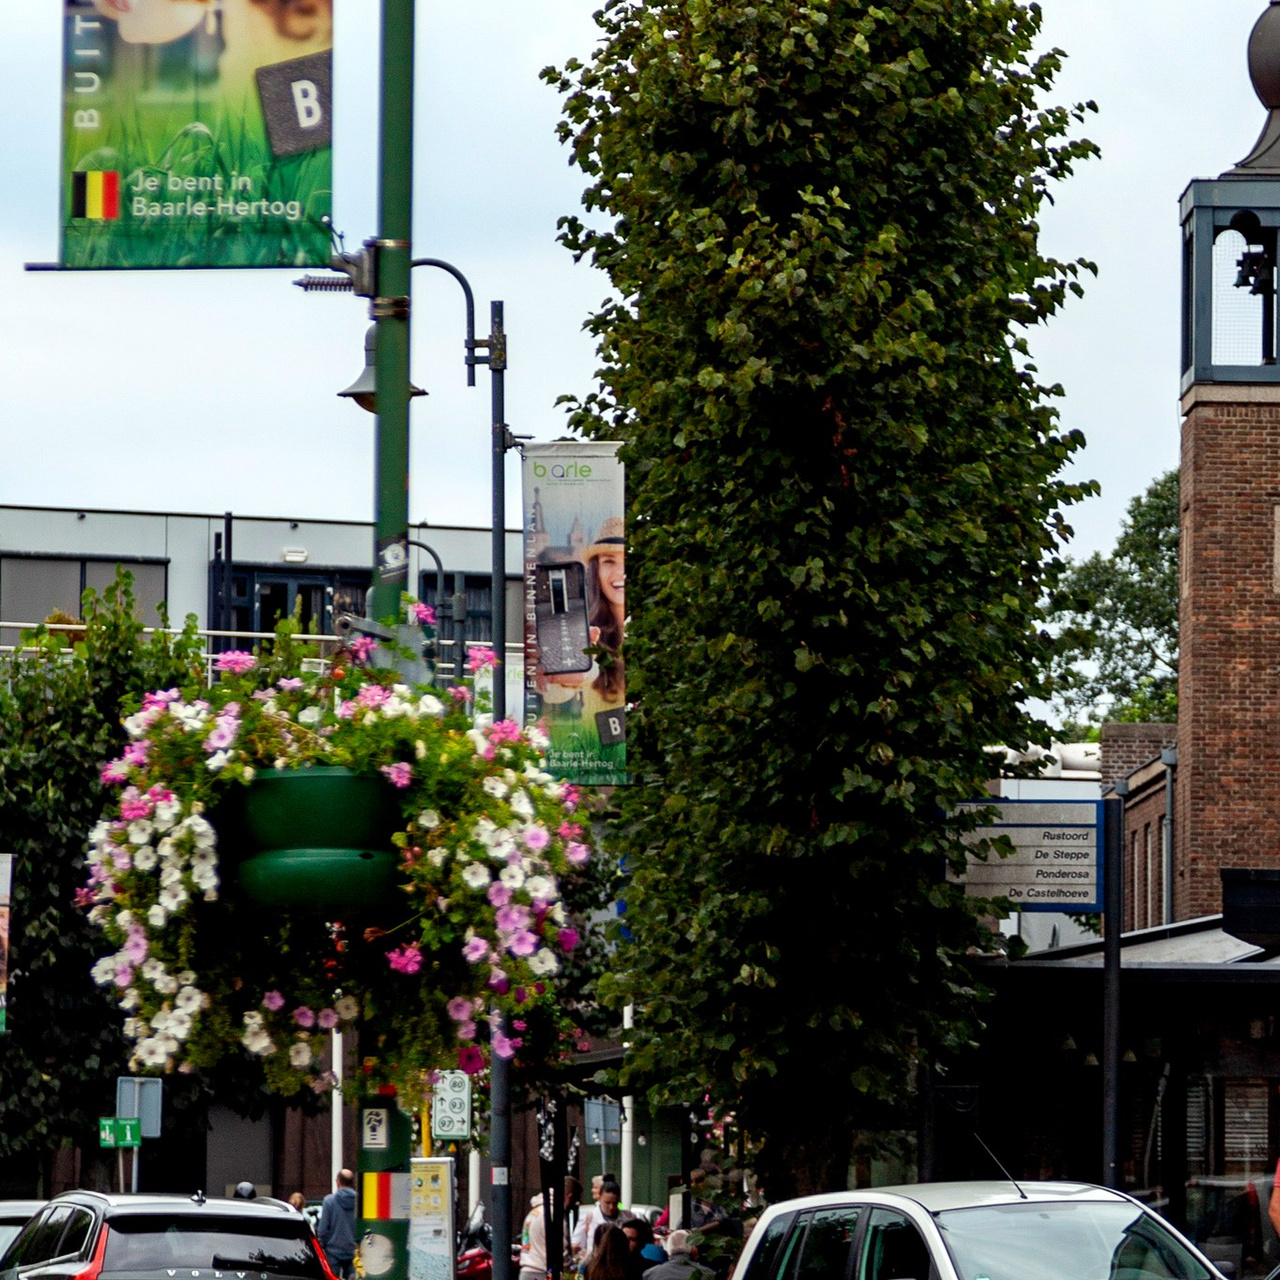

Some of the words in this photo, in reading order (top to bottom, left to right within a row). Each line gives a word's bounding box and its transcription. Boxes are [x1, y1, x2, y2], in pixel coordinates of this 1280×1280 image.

[291, 80, 321, 128] B
[132, 171, 159, 191] Je
[167, 171, 223, 191] bent
[230, 170, 252, 190] in
[132, 195, 301, 221] Baarle-Hertog
[527, 634, 538, 653] IN
[526, 665, 538, 730] UITEN
[608, 717, 621, 735] B
[562, 750, 584, 758] bent
[549, 759, 614, 769] Baarle-Hertog
[1042, 831, 1089, 840] Rustoord
[1035, 850, 1049, 859] De
[1053, 850, 1090, 860] Steppe
[1035, 869, 1090, 878] Ponderosa
[1009, 888, 1023, 897] De
[1027, 888, 1089, 898] Castelhoeve
[451, 1080, 463, 1088] 80
[451, 1102, 463, 1110] 93
[440, 1120, 453, 1128] 97
[166, 1269, 267, 1280] VOLVO
